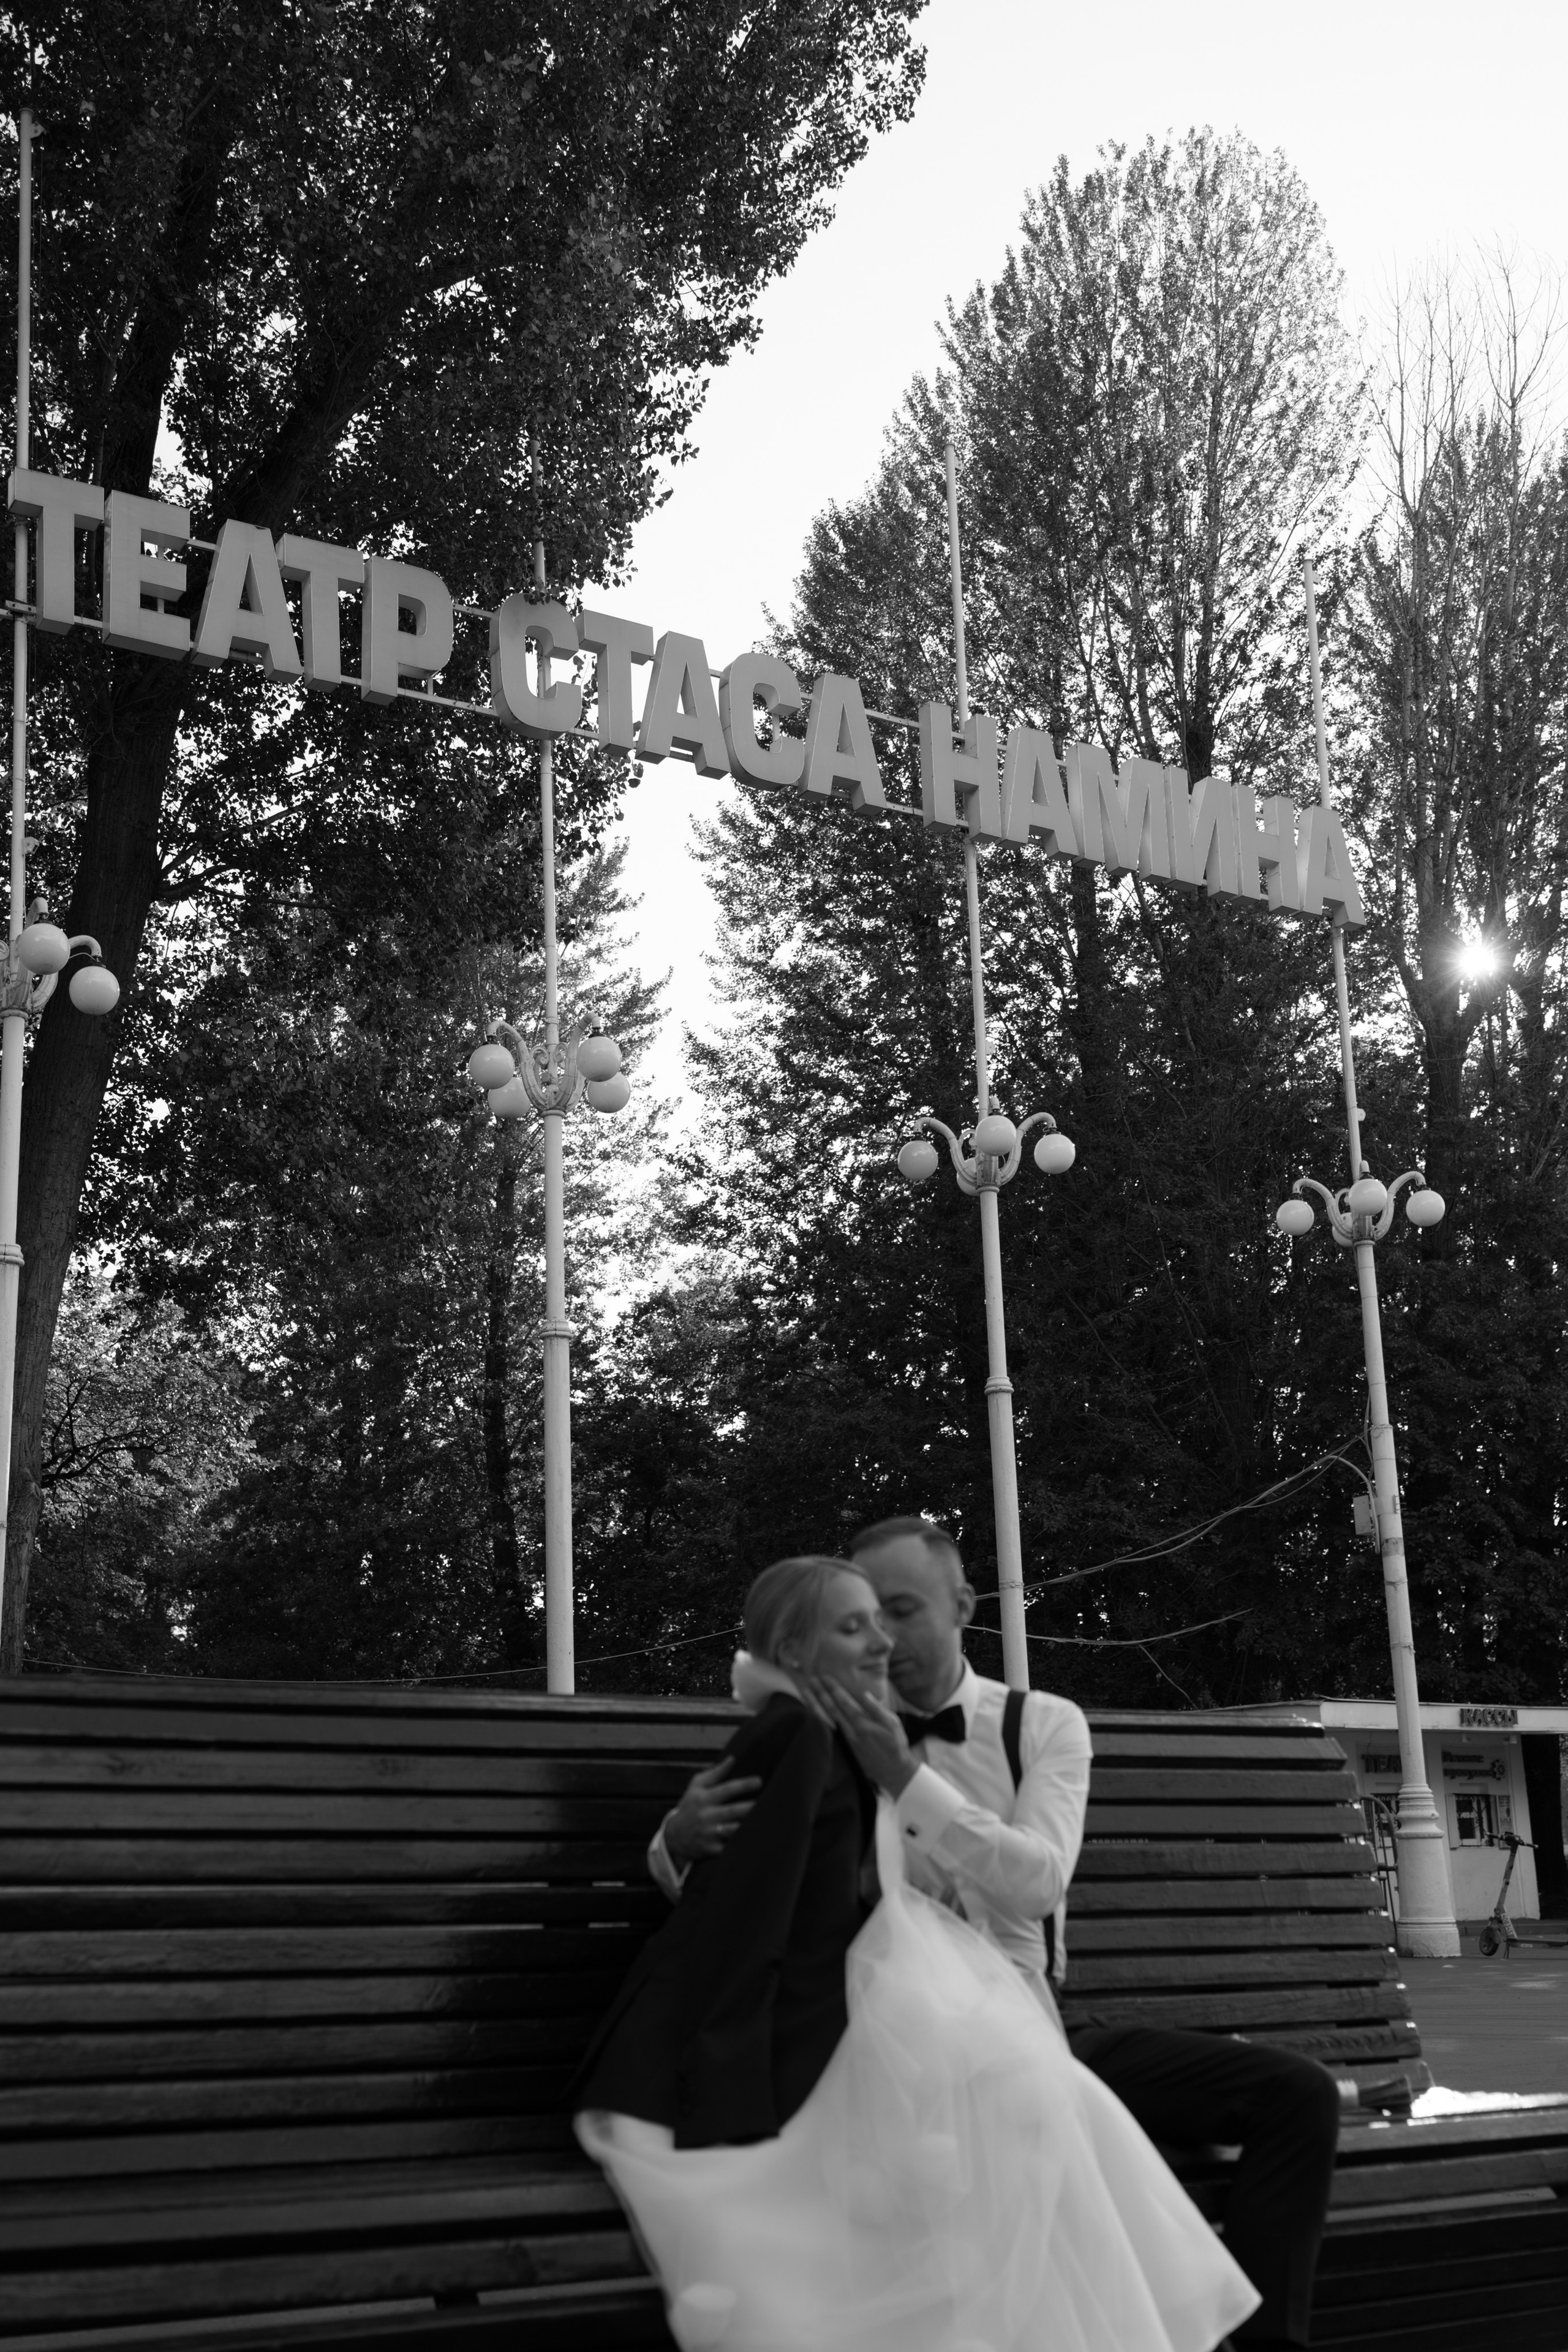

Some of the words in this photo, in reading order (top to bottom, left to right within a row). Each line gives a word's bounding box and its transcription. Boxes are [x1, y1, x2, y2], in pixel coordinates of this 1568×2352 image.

[8, 467, 453, 705] ТЕАТР
[491, 592, 887, 815] СТАСА
[919, 701, 1366, 930] НАМИНА
[1460, 1708, 1518, 1726] КАССЫ
[1362, 1754, 1403, 1773] ТЕА
